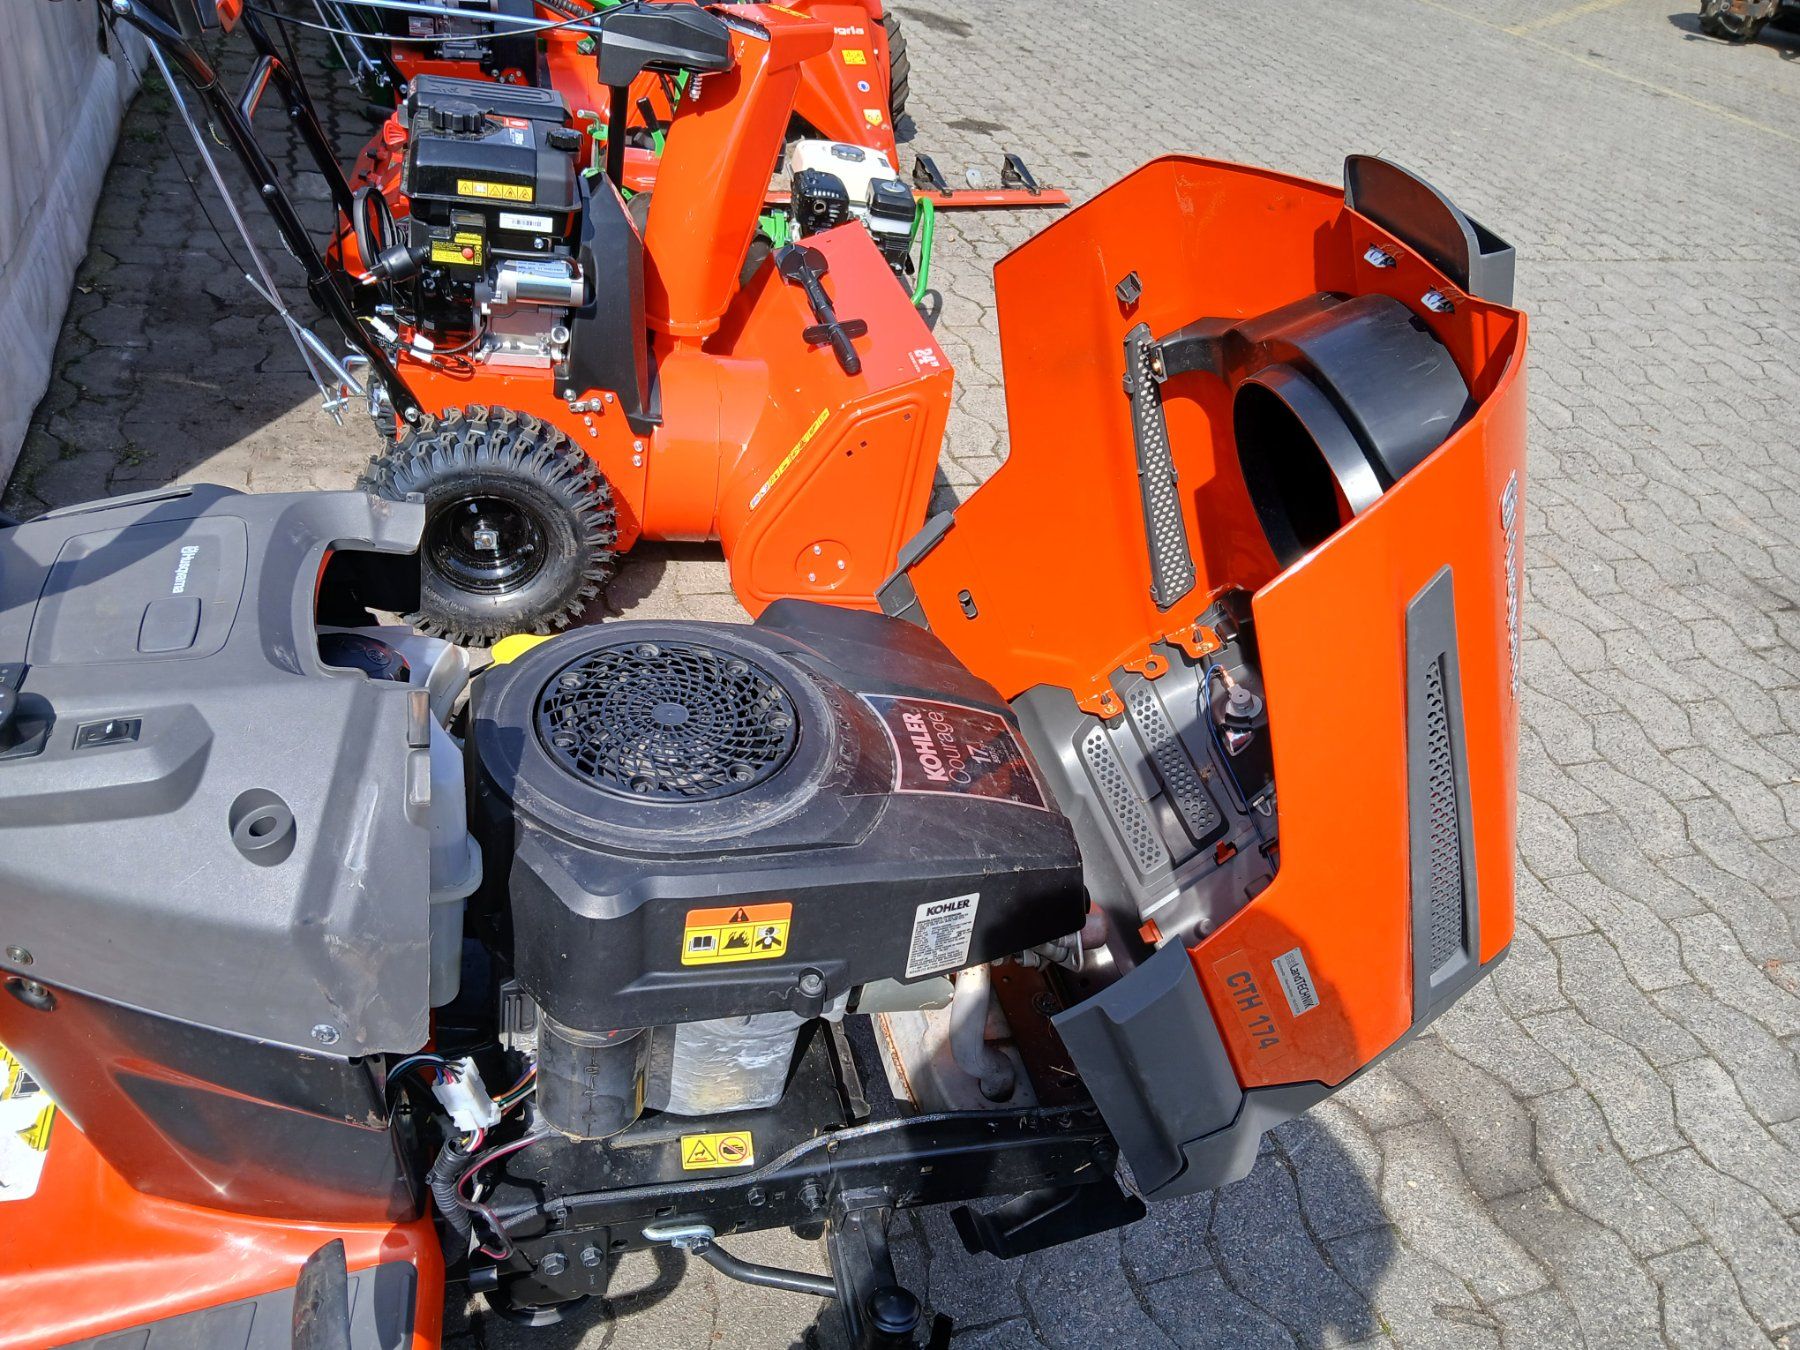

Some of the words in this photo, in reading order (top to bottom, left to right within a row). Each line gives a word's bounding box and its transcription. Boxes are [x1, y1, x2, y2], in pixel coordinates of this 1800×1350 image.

[902, 712, 949, 781] KOHLER
[928, 711, 971, 784] Courage
[966, 744, 992, 764] 17
[926, 899, 970, 916] KOHLER
[1227, 971, 1263, 1011] CTH
[1248, 1015, 1280, 1050] 174
